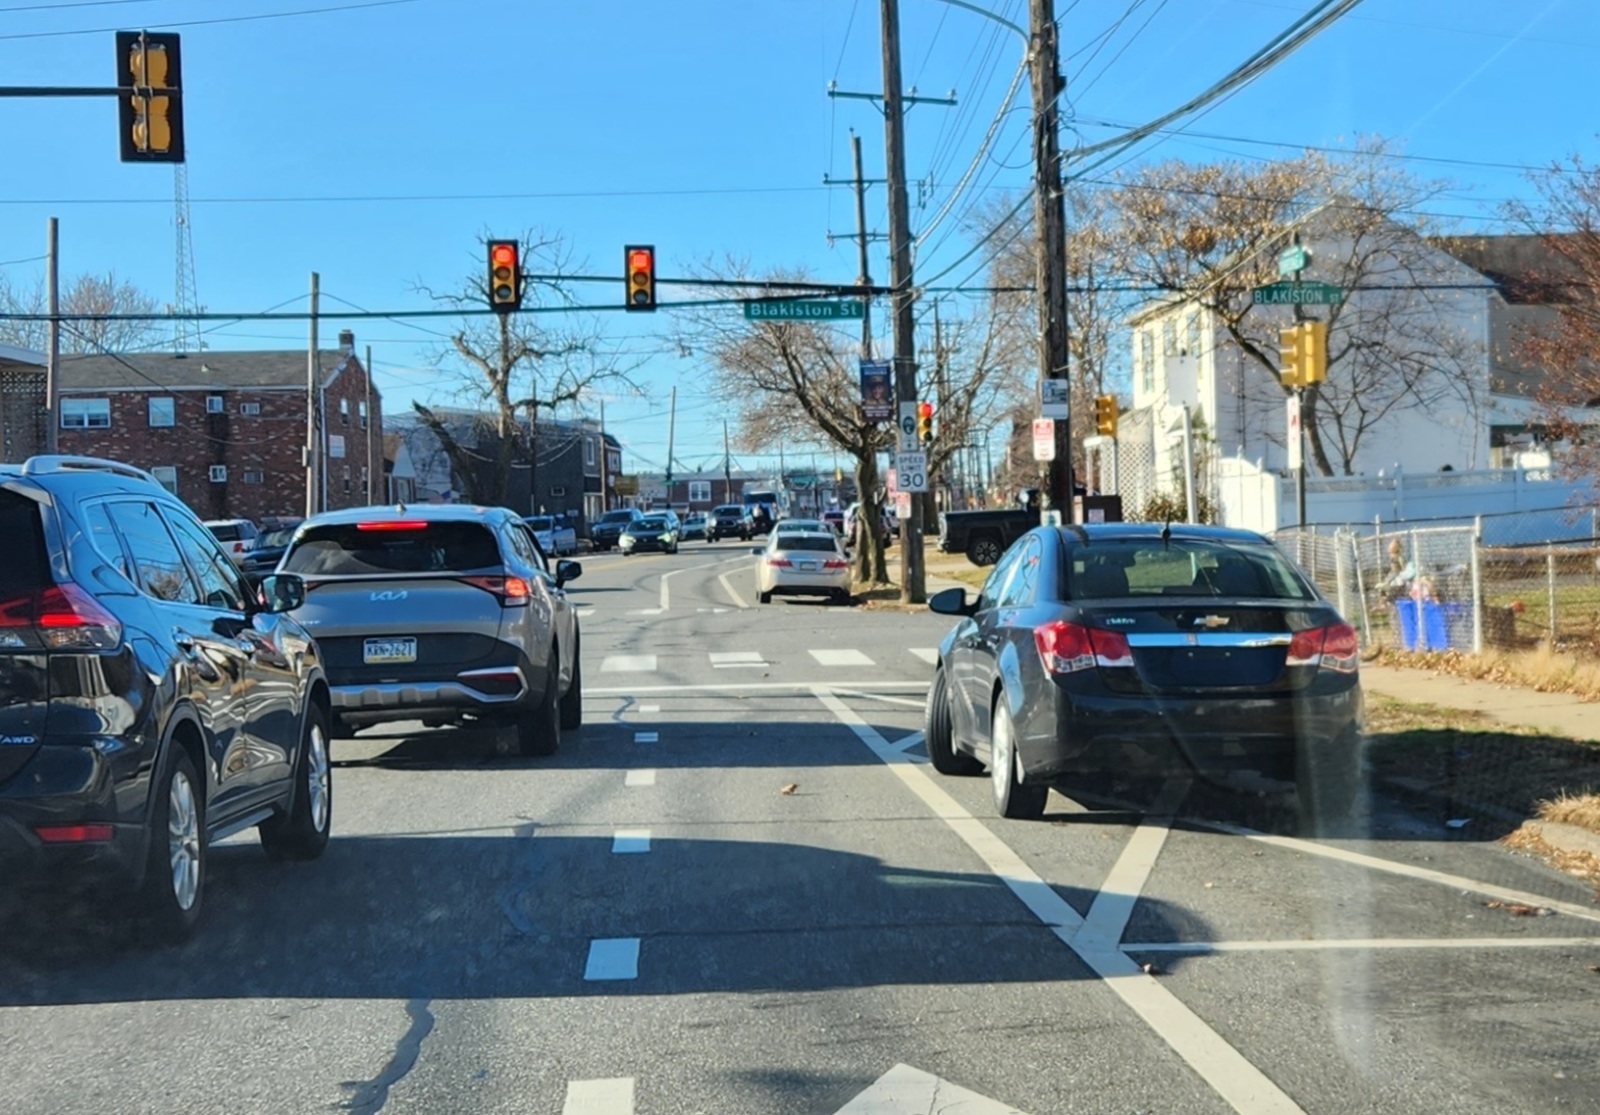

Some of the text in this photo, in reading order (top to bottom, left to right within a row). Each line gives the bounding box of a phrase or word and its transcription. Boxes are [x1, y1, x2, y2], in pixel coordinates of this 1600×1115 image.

[1254, 290, 1339, 303] BLAKISTON ST
[750, 303, 857, 316] Blakiston St
[898, 456, 925, 464] SPEED
[900, 464, 922, 473] LIMIT
[900, 473, 924, 487] 30
